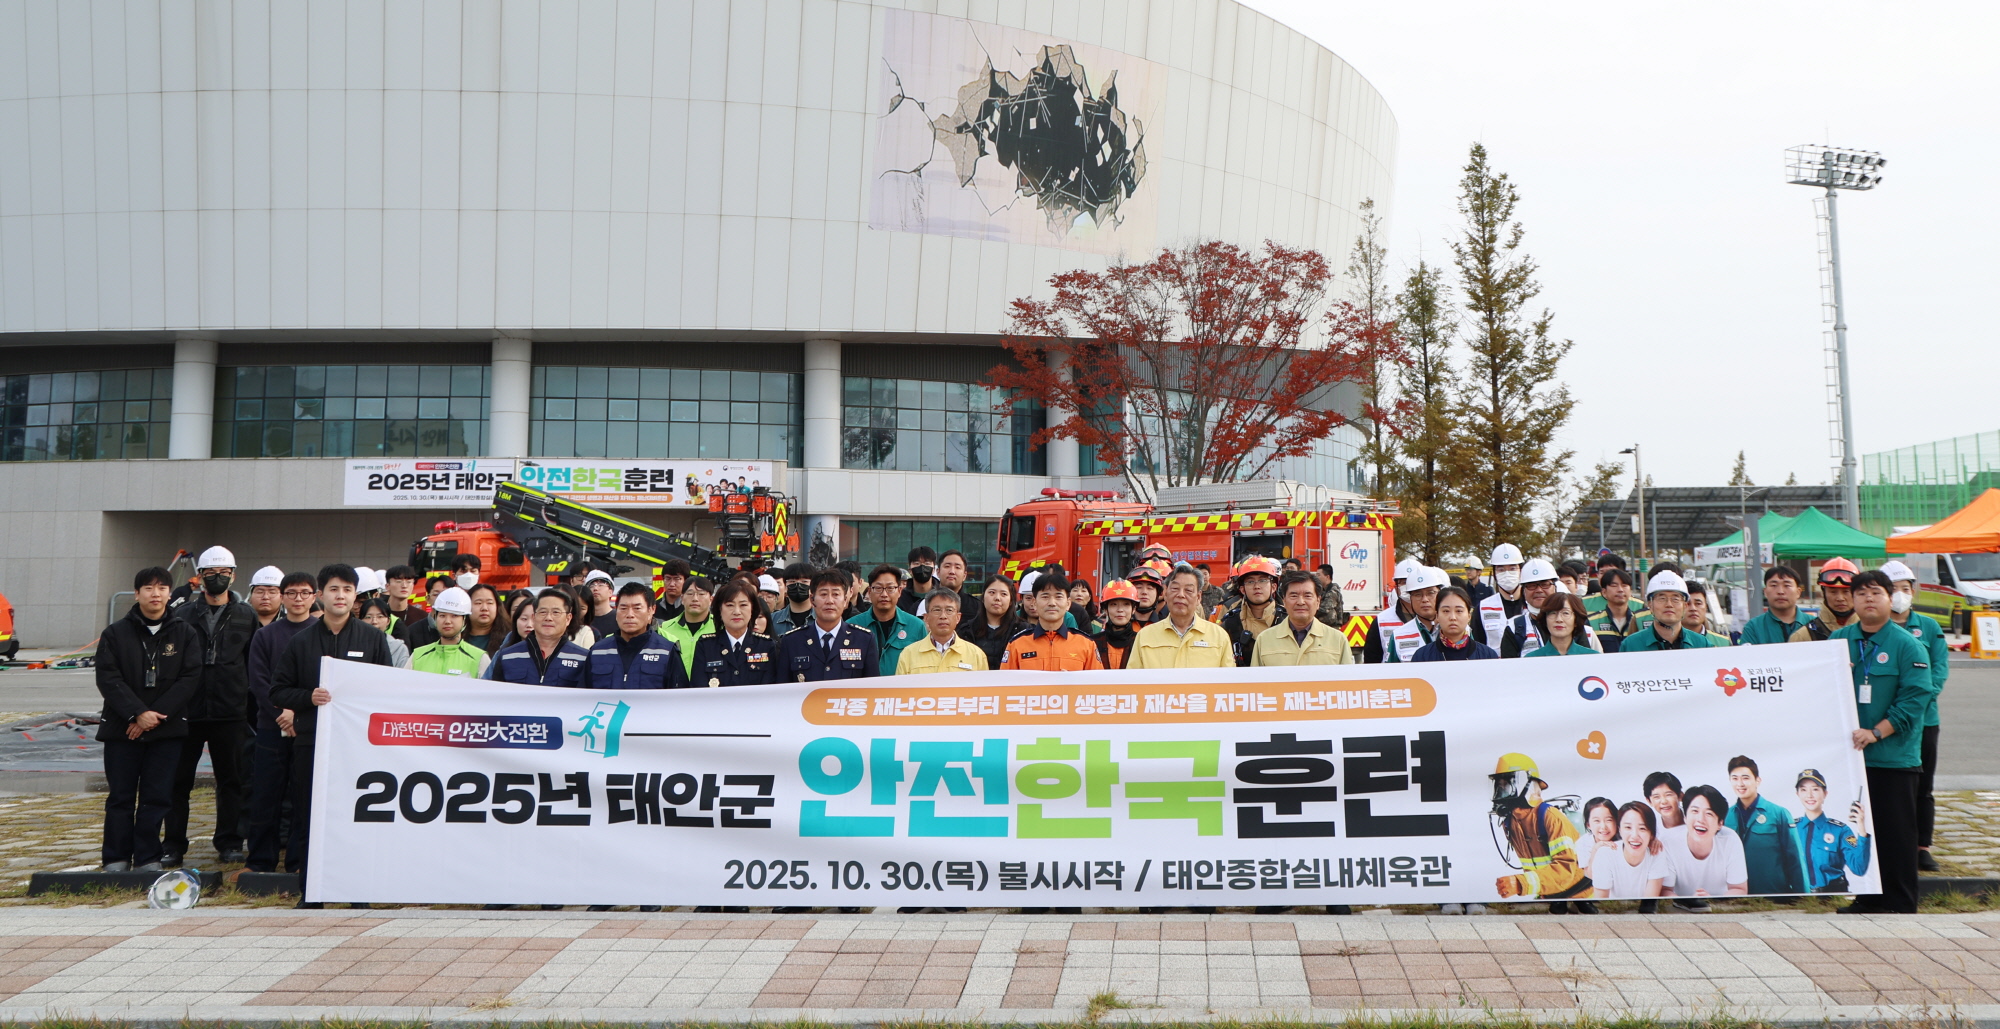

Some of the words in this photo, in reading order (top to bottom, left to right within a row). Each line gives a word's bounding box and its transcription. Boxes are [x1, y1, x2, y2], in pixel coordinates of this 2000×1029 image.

[368, 473, 451, 491] 2025년
[581, 519, 640, 548] 태안소방서
[546, 561, 568, 572] 119
[561, 659, 579, 668] 태안군
[642, 653, 660, 662] 태안군
[1616, 678, 1693, 694] 행정안전부
[1750, 675, 1784, 693] 태안
[825, 697, 868, 717] 각종
[872, 695, 1000, 717] 재난으로부터
[1006, 694, 1069, 716] 국민의
[1074, 693, 1139, 715] 생명과
[1144, 692, 1208, 714] 재산을
[1214, 691, 1278, 712] 지키는
[1283, 688, 1412, 711] 재난대비훈련
[382, 721, 445, 740] 대한민국
[448, 721, 549, 744] 안전大전환
[353, 770, 592, 826] 2025년
[606, 772, 775, 828] 태안군
[798, 730, 1451, 839] 안전한국훈련
[723, 860, 818, 891] 2025.
[827, 860, 871, 890] 10.
[880, 860, 989, 892] 30.(목)
[998, 861, 1126, 891] 불시시작
[1133, 859, 1153, 892] /
[1162, 856, 1452, 890] 태안종합실내체육관
